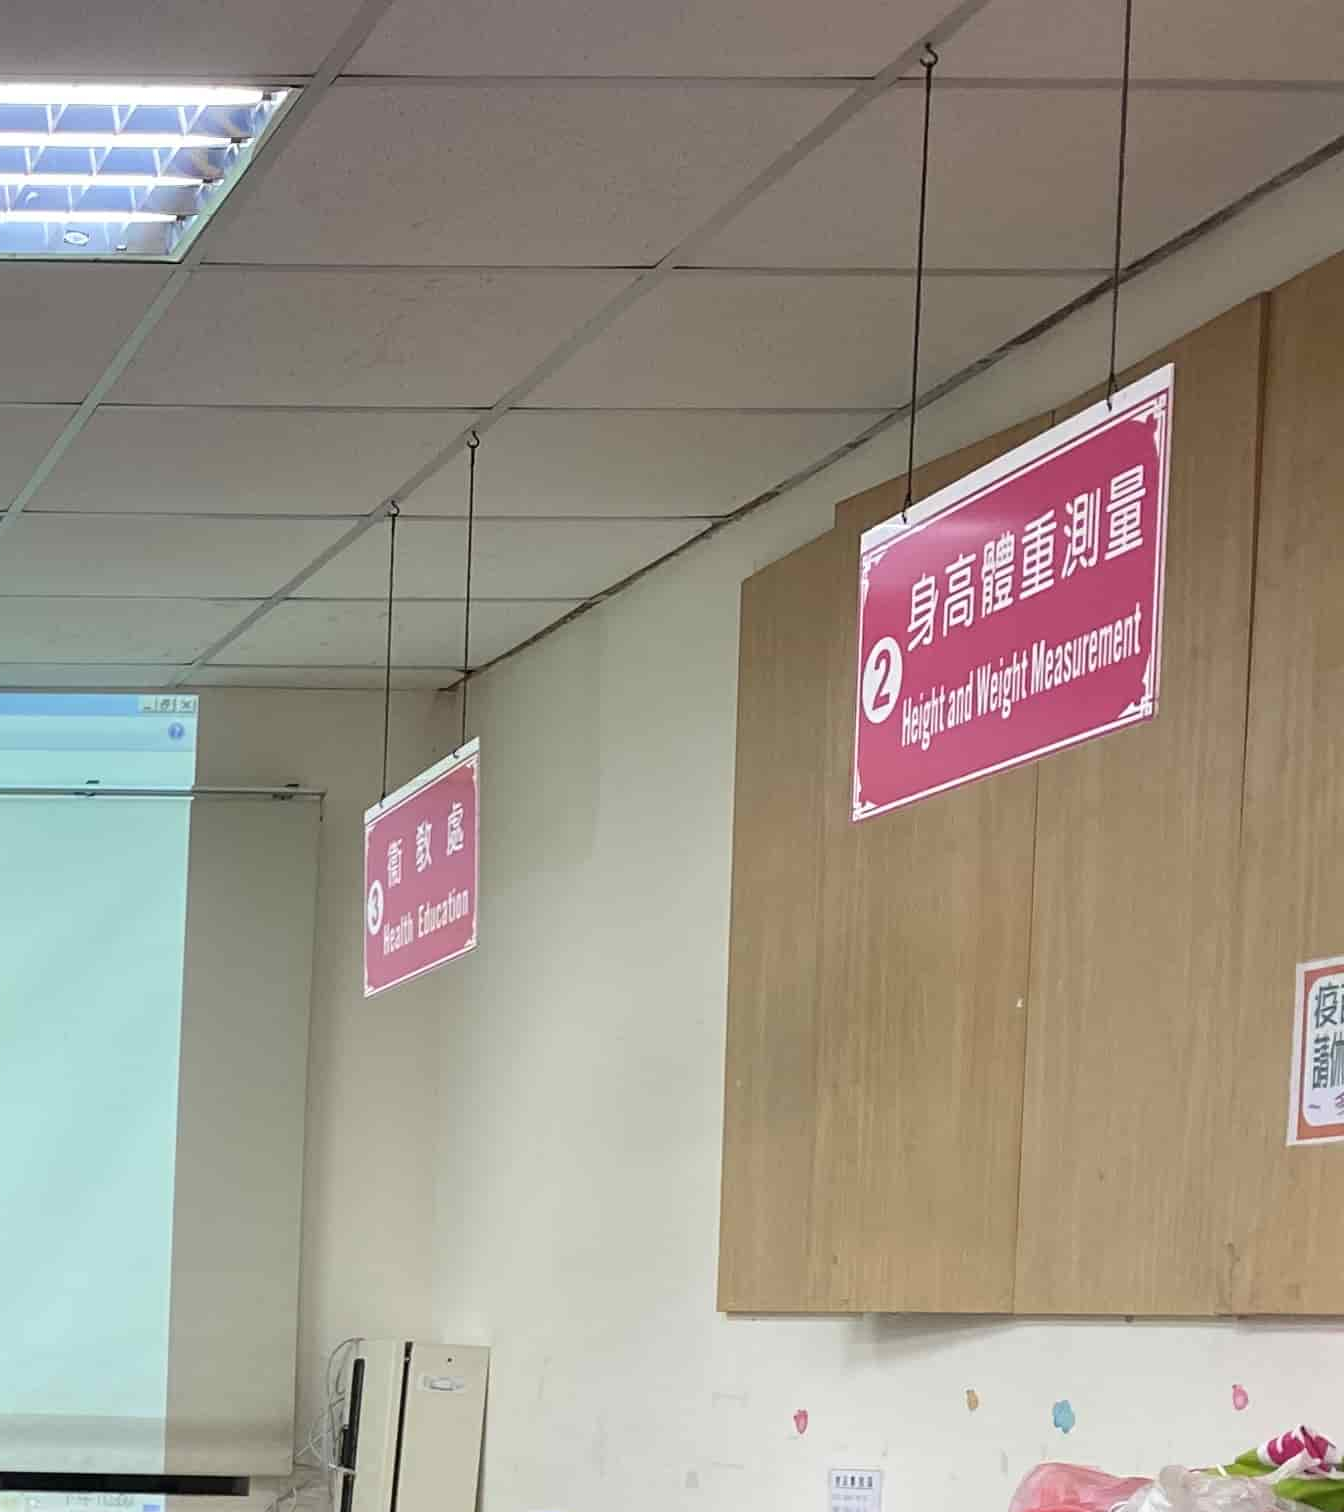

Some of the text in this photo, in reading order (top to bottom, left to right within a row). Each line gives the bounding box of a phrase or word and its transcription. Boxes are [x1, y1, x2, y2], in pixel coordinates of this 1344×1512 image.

[906, 463, 1148, 652] 身高體重測量
[871, 648, 892, 710] 2
[901, 601, 1143, 751] Height and Weight Measurement
[382, 889, 470, 957] Health Education
